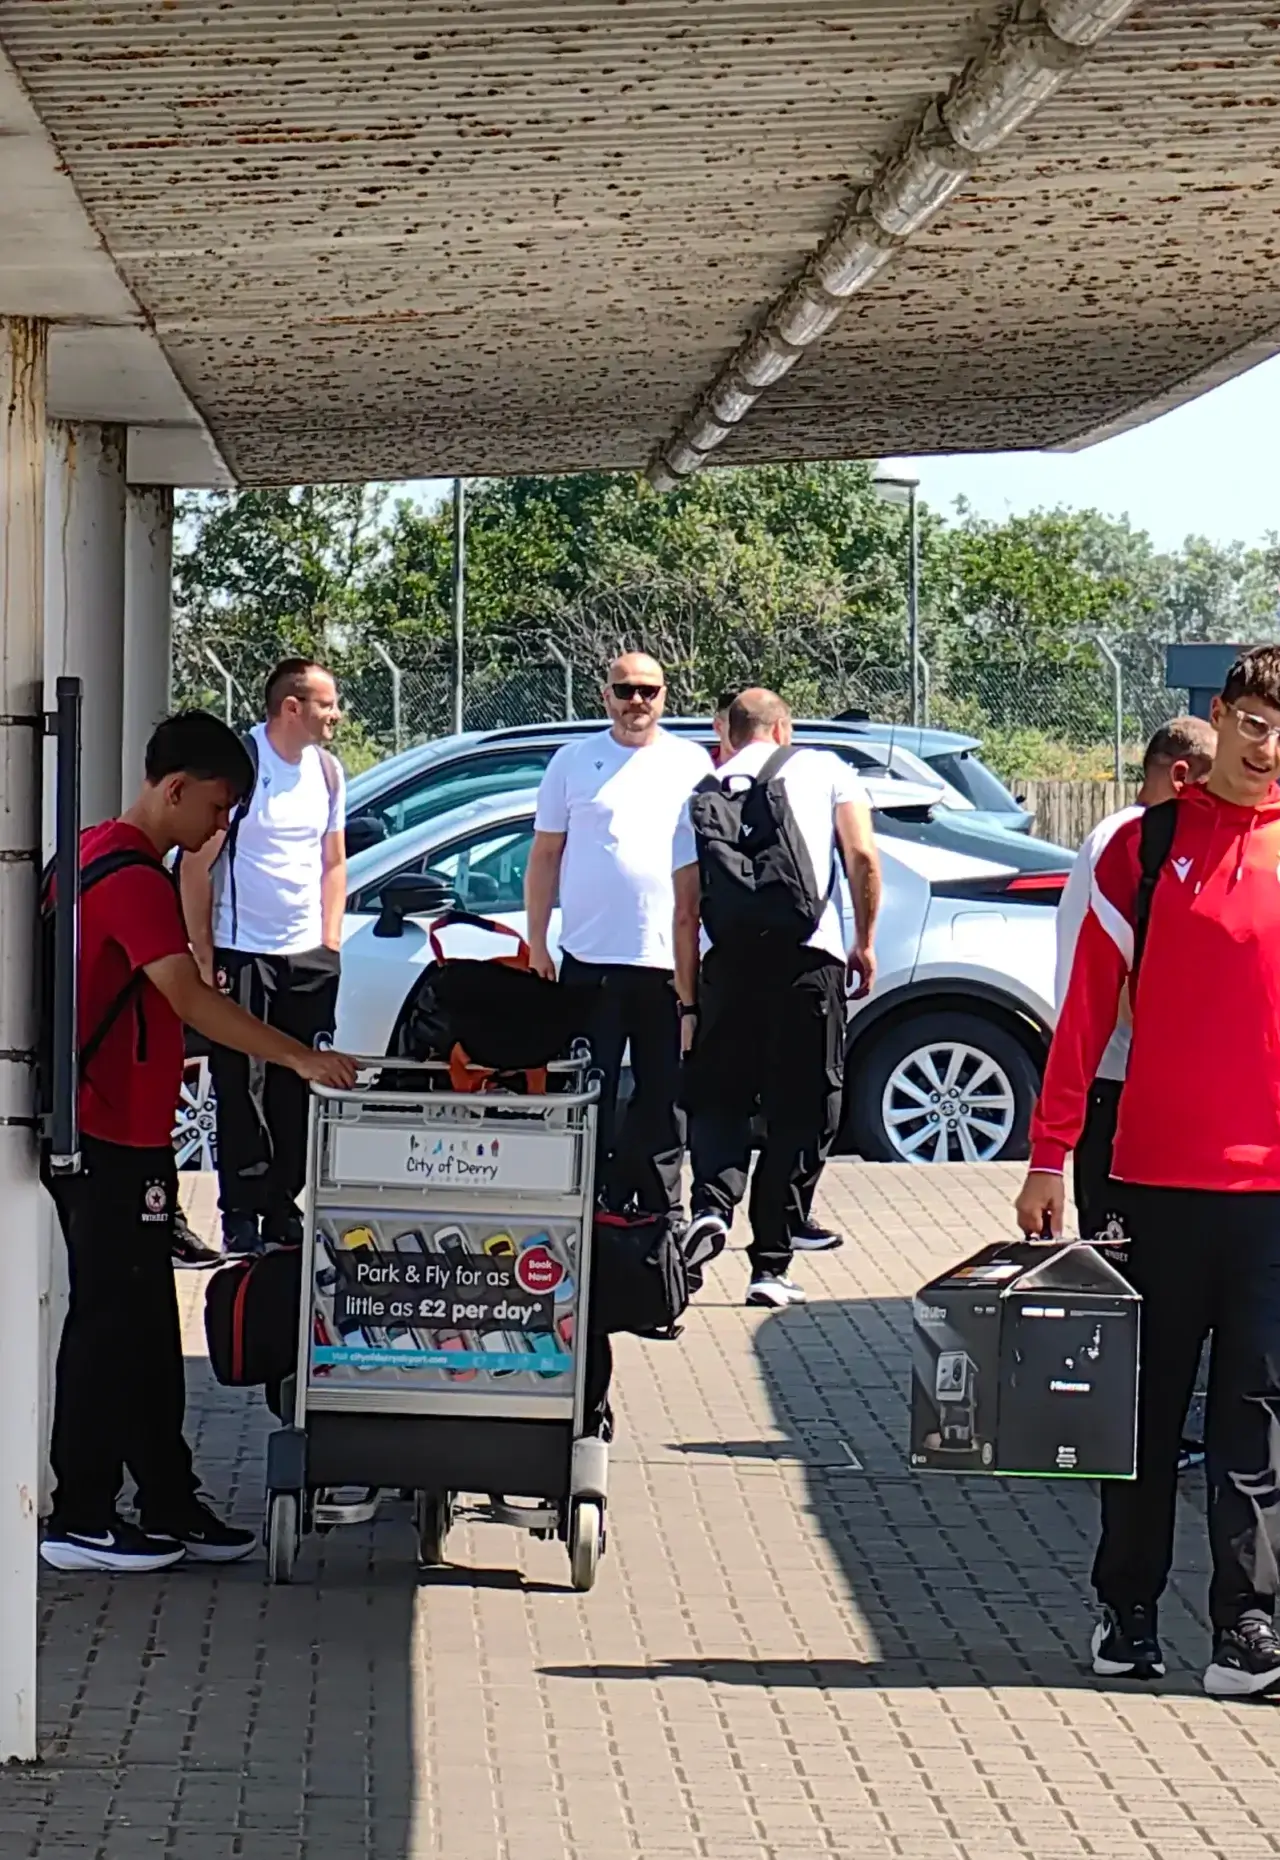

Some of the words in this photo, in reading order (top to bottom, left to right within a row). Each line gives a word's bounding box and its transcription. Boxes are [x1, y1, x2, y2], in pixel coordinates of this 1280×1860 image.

[406, 1156, 434, 1178] City
[438, 1155, 454, 1174] of
[456, 1158, 499, 1181] Derry
[357, 1263, 400, 1283] Park
[405, 1265, 421, 1283] &
[426, 1264, 450, 1289] Fly
[456, 1265, 482, 1285] for
[486, 1272, 510, 1287] as
[528, 1260, 552, 1269] Book
[346, 1295, 385, 1316] little
[390, 1302, 413, 1318] as
[418, 1299, 447, 1318] £2
[452, 1303, 488, 1323] per
